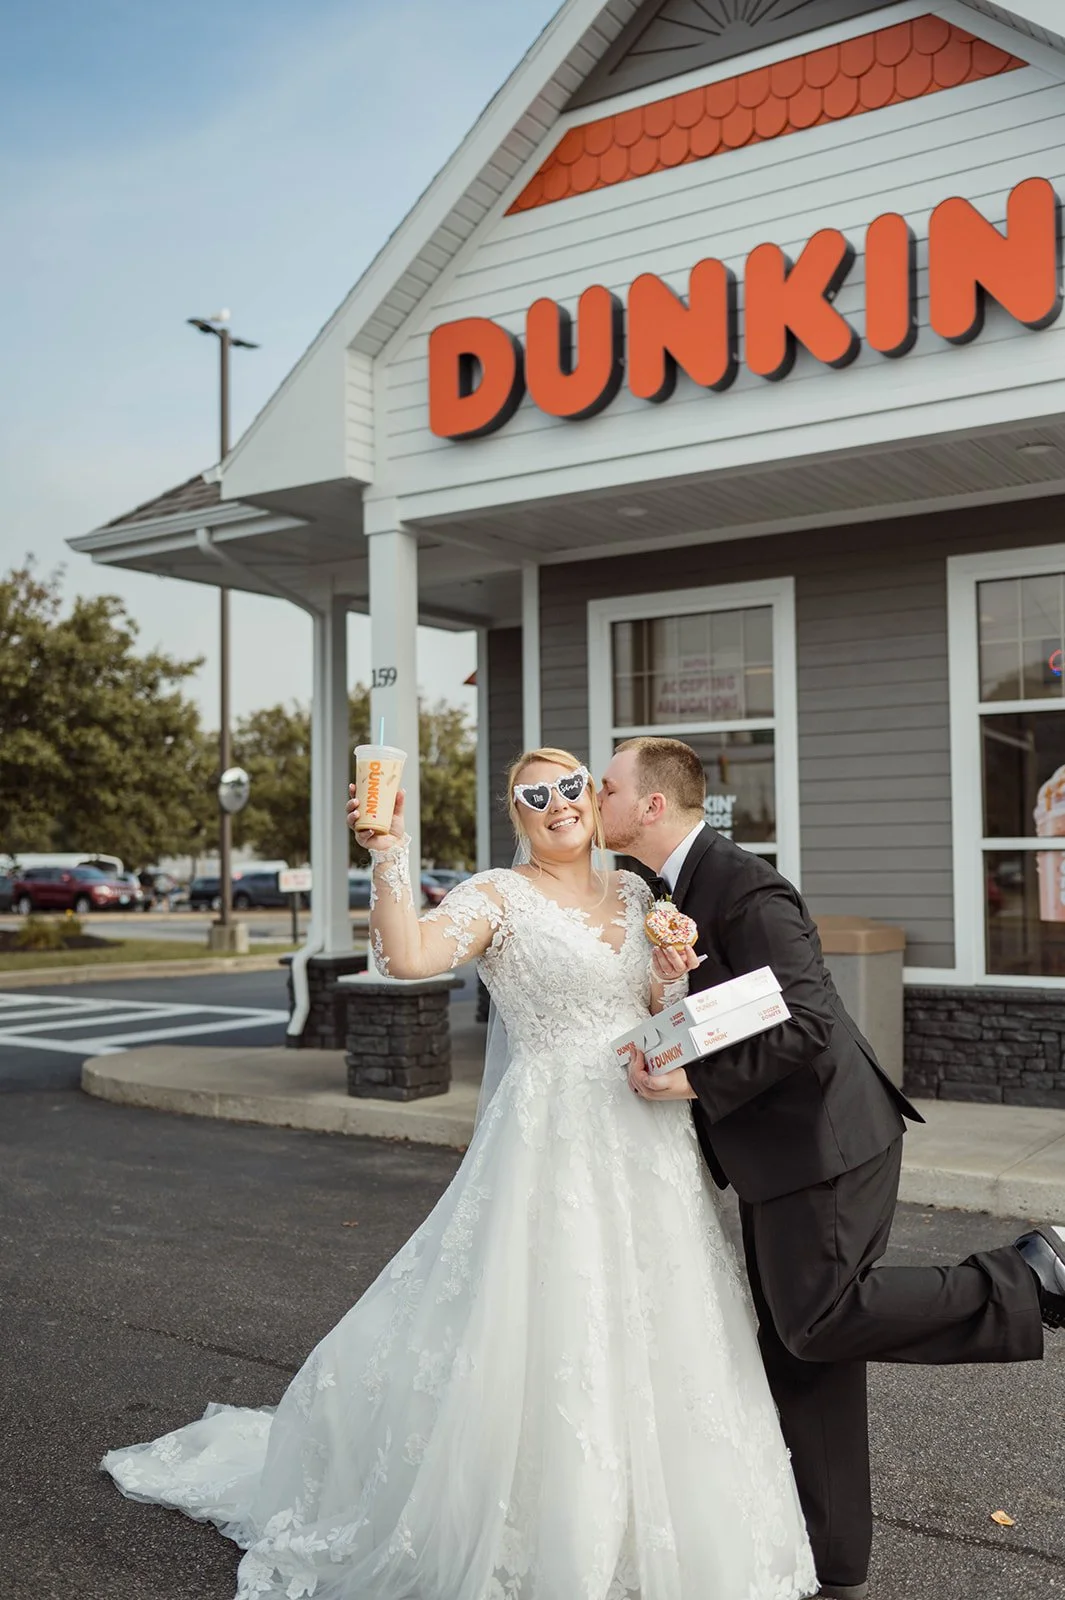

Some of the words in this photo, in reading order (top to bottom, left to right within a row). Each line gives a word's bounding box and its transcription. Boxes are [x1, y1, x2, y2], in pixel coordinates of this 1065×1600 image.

[429, 177, 1060, 440] DUNKIN
[372, 667, 397, 688] 159
[366, 761, 380, 818] DUNKIN'
[704, 795, 737, 813] KIN'
[655, 1042, 684, 1069] DUNKIN'
